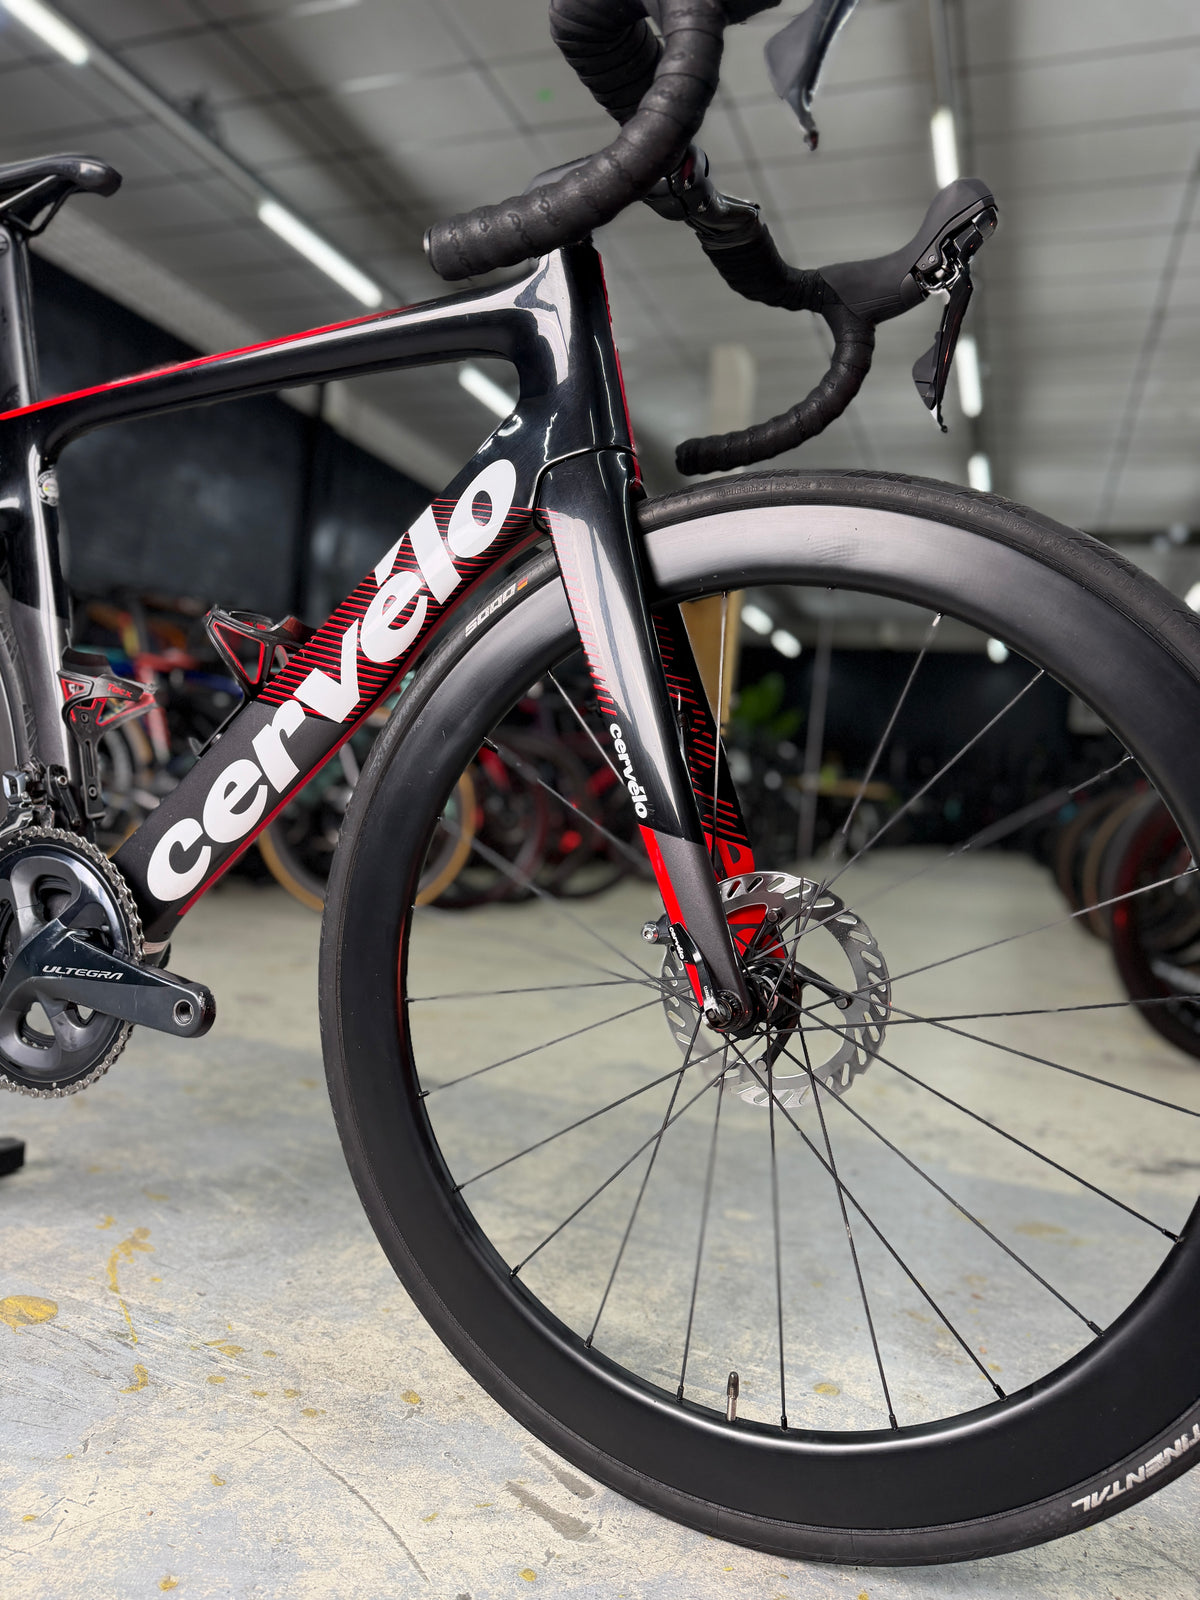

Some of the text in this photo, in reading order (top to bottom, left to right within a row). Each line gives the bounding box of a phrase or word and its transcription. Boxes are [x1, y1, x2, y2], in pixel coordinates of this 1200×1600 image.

[465, 583, 517, 638] 5000
[147, 459, 517, 901] cervélo
[609, 723, 648, 819] cervélo
[42, 965, 124, 980] ULTEGRA
